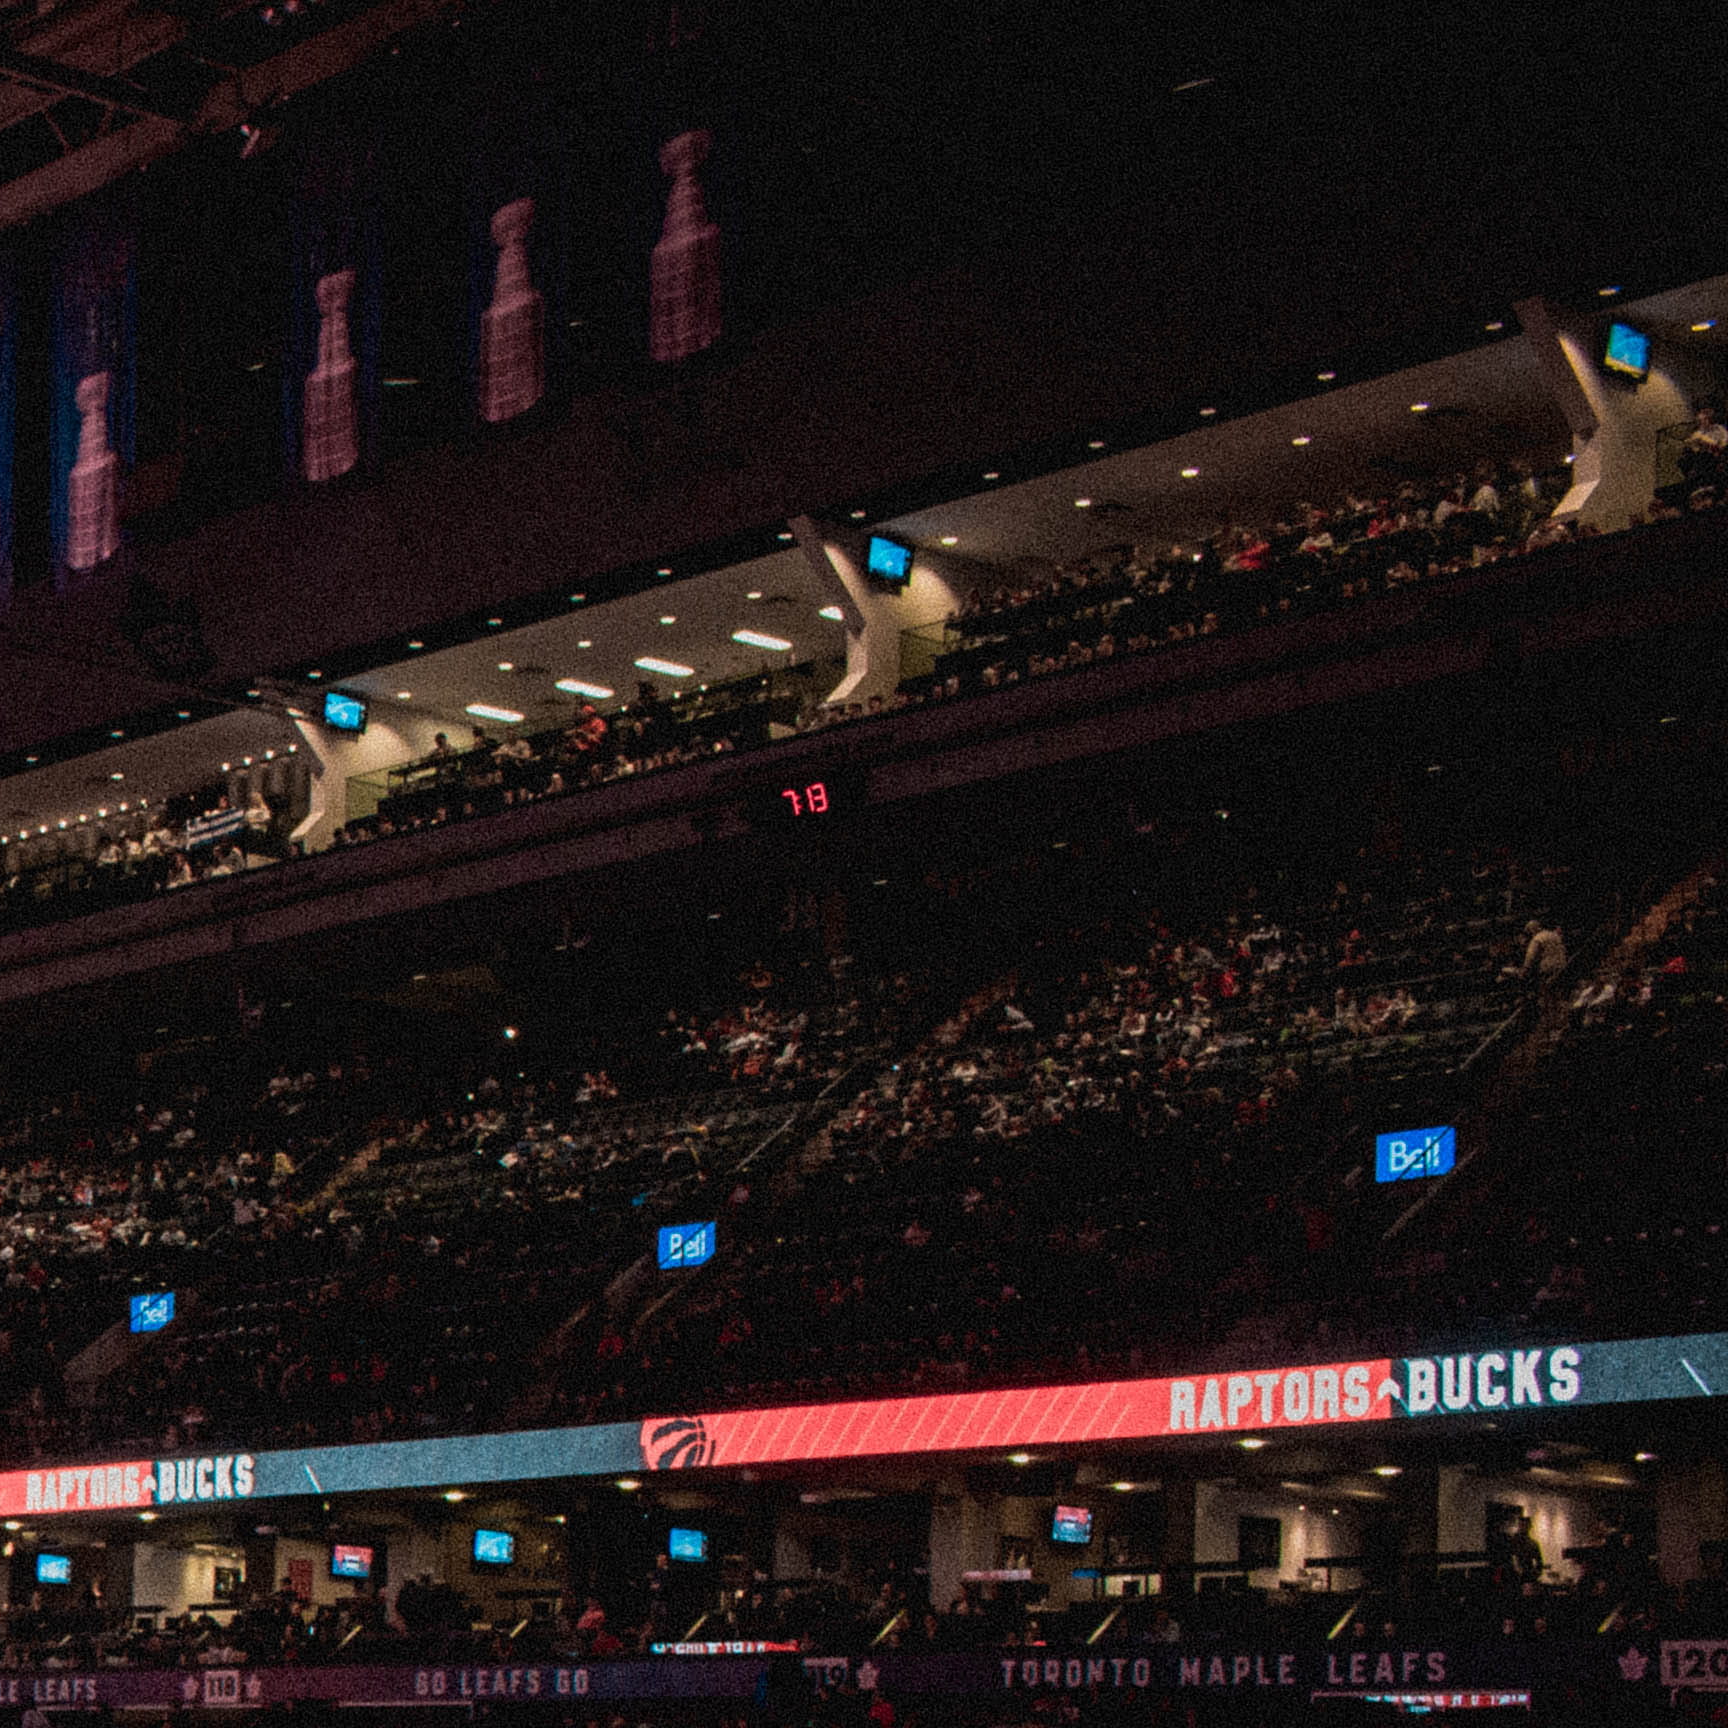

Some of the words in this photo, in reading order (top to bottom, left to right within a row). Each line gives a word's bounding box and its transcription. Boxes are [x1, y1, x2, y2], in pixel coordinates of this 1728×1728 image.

[1389, 1138, 1442, 1171] Bell
[669, 1231, 707, 1260] Bell
[1170, 1365, 1372, 1432] RAPTORS
[1408, 1346, 1582, 1415] BUCKS
[25, 1463, 140, 1512] RAPTORS
[156, 1452, 255, 1503] BUCKS
[458, 1668, 543, 1697] LEAFS
[999, 1656, 1152, 1690] TORONTO
[1180, 1652, 1297, 1688] MAPLE
[1327, 1650, 1449, 1685] LEAFS
